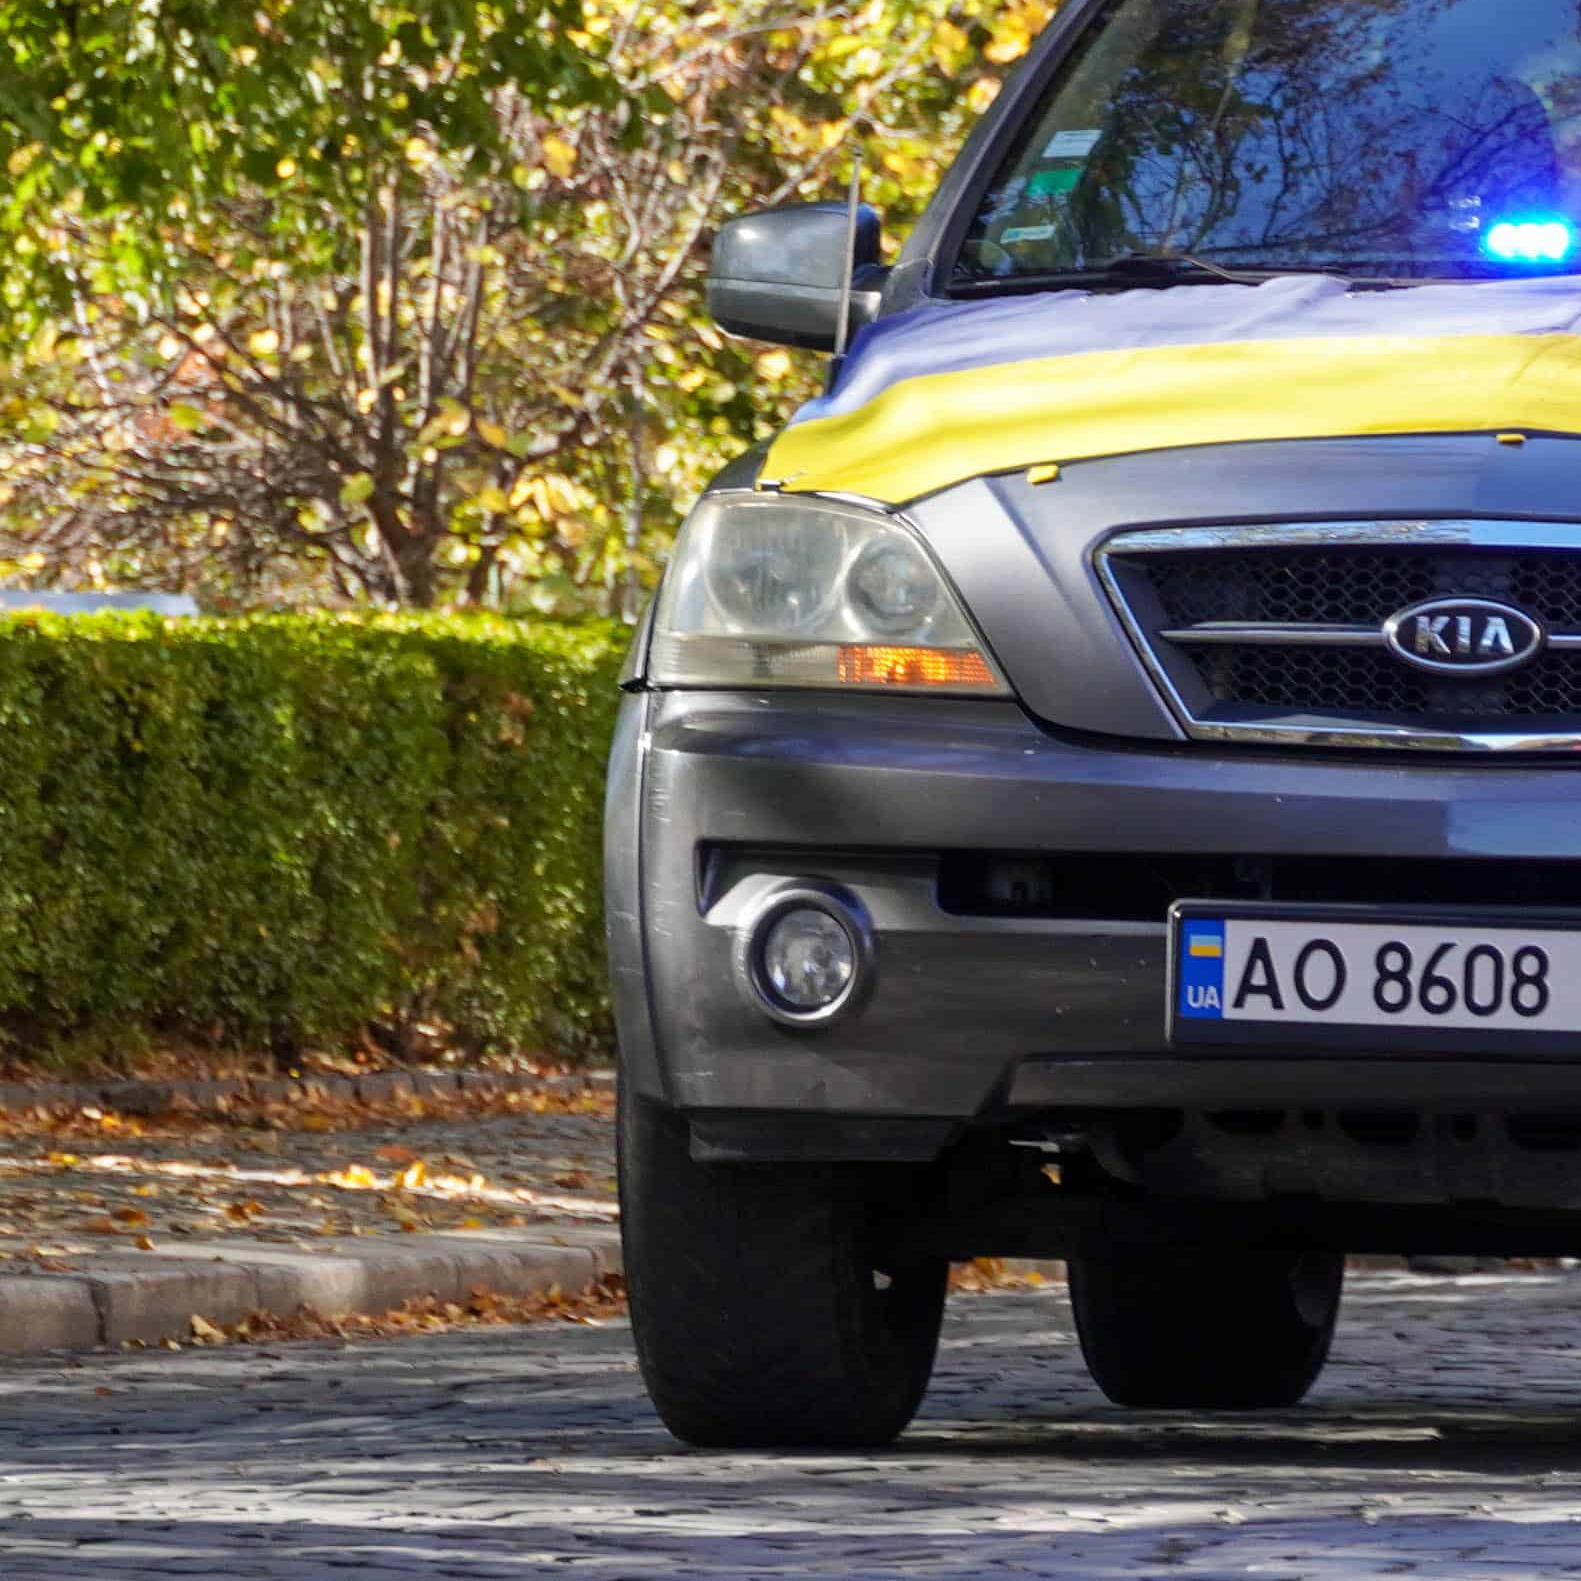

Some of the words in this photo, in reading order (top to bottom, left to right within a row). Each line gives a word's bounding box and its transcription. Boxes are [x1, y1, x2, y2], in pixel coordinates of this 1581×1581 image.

[1415, 615, 1515, 655] KIA
[1187, 985, 1221, 1009] UA
[1232, 937, 1346, 1011] AO
[1373, 941, 1550, 1017] 8608
